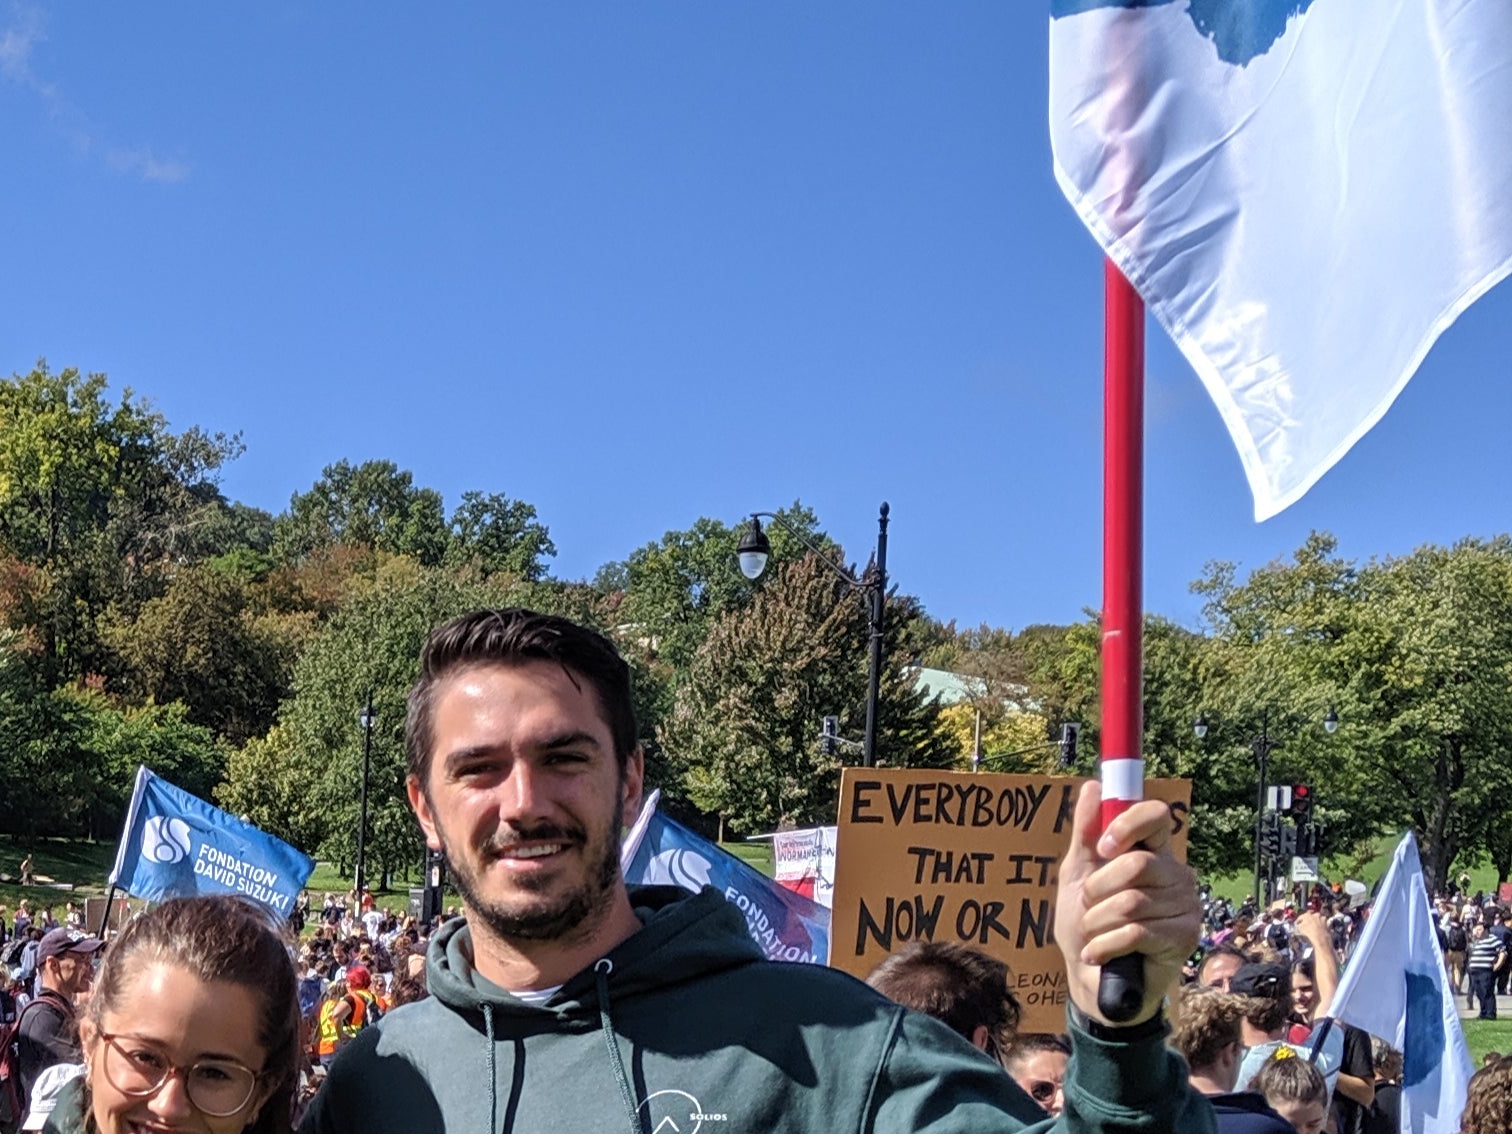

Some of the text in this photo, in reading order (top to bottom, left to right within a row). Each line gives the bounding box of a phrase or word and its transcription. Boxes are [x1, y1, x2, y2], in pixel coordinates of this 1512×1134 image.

[850, 780, 1052, 832] EVERYBODY
[193, 858, 290, 910] DAVID SUZUKI
[198, 843, 278, 888] FONDATION
[907, 846, 995, 884] THAT
[725, 886, 818, 964] FONDATION
[854, 894, 945, 956] NOW
[955, 899, 1011, 944] OR
[1007, 971, 1068, 989] EONA
[1010, 989, 1067, 1006] OHE
[689, 1112, 728, 1121] SOLIOS
